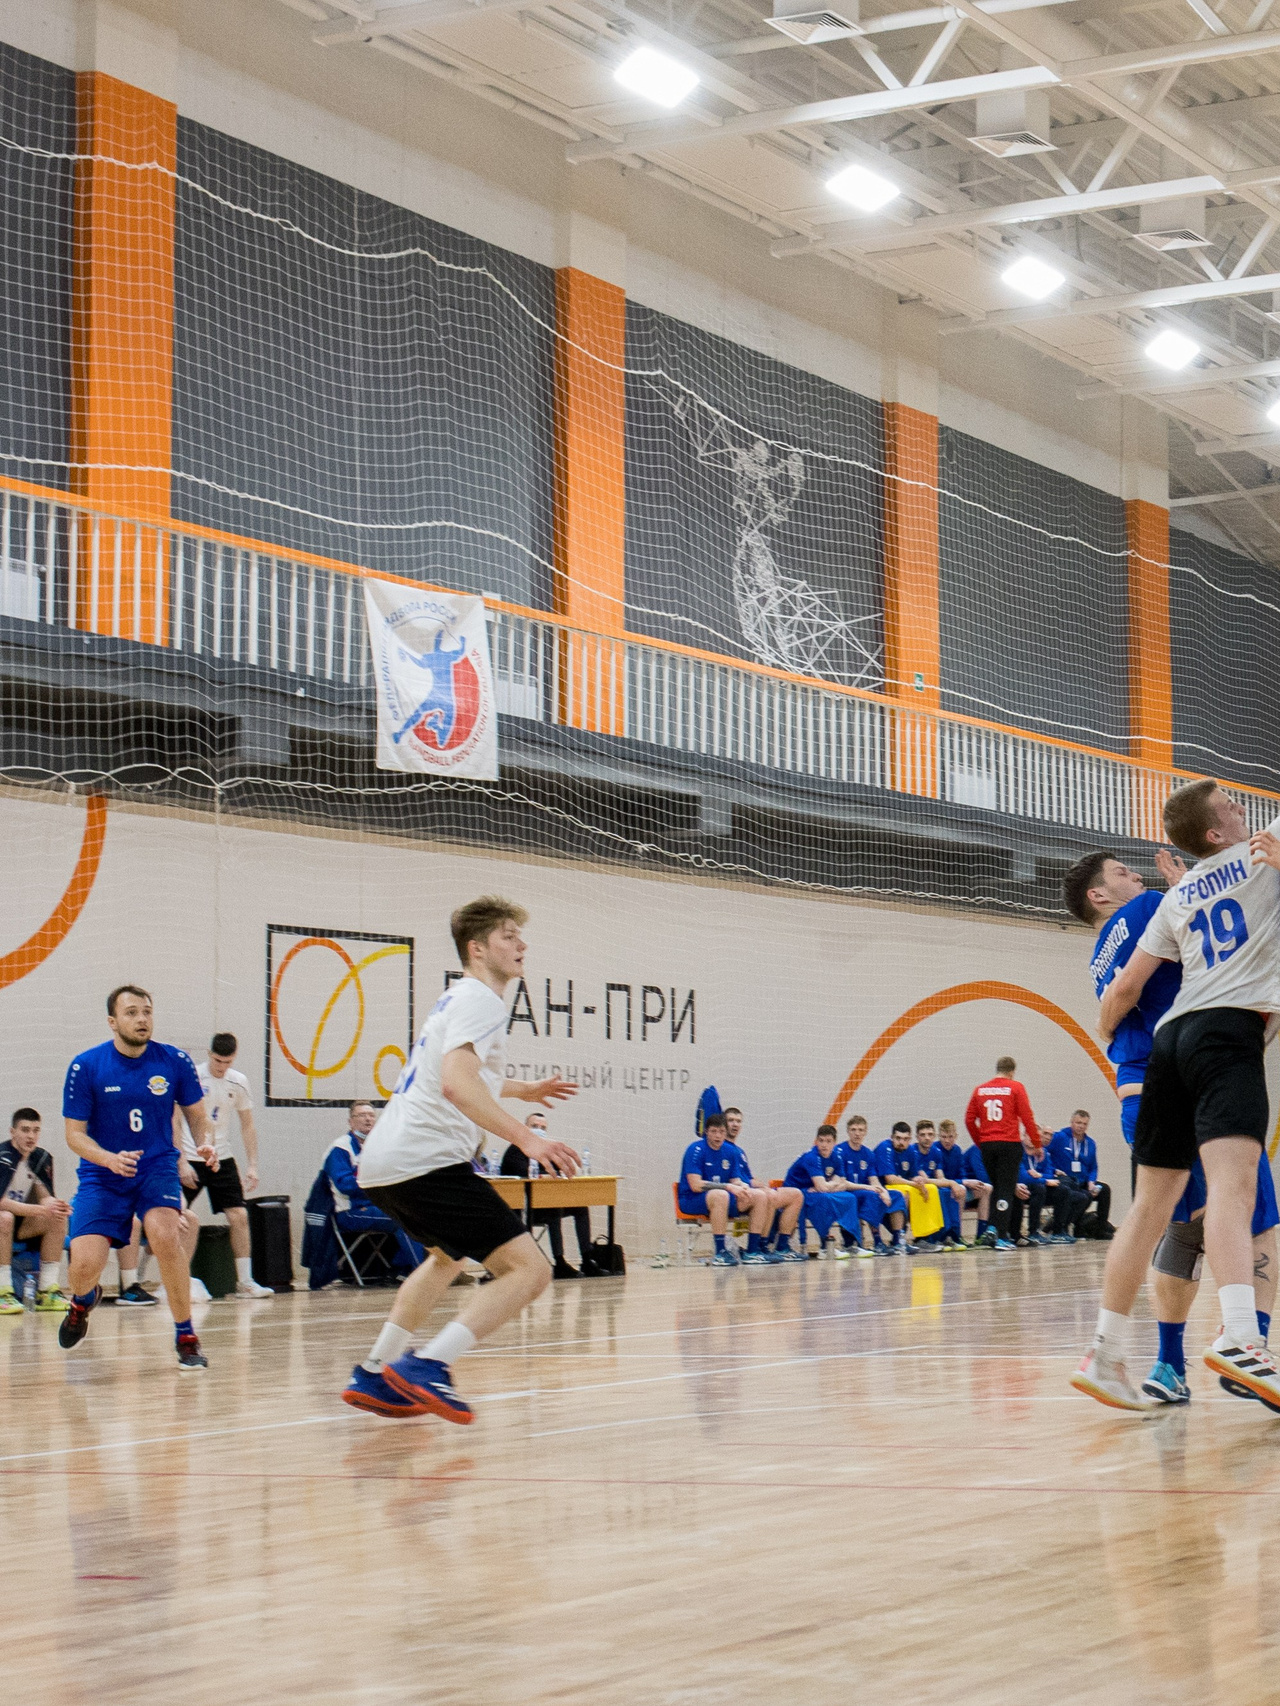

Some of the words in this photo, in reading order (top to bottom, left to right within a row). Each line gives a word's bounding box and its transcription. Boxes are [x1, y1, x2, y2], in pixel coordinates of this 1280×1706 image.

[1189, 898, 1249, 969] 19
[444, 970, 697, 1044] АН-ПРИ
[623, 1067, 691, 1094] ЦЕНТР
[128, 1108, 144, 1132] 6
[983, 1099, 1003, 1121] 16
